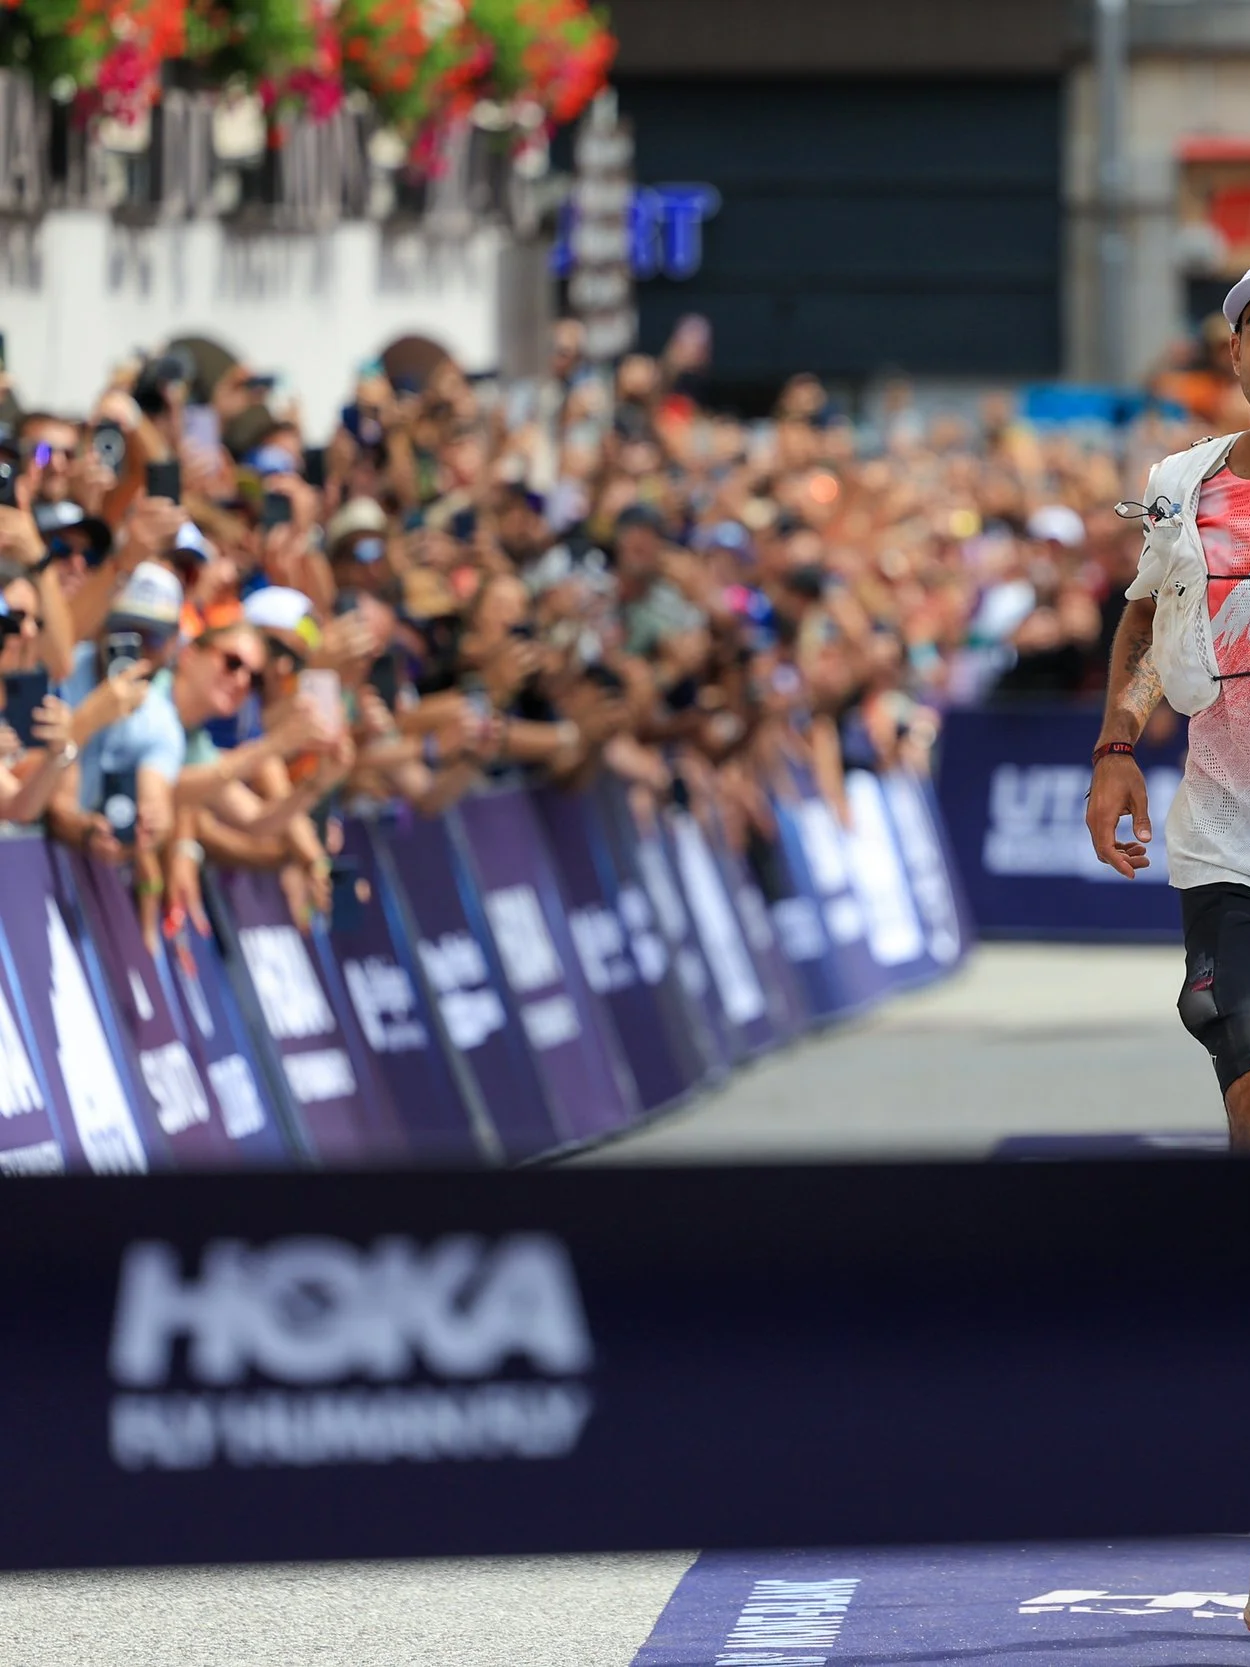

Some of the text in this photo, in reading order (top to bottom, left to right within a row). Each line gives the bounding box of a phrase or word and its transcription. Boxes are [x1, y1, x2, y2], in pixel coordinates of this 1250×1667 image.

[1113, 744, 1132, 752] UTM
[112, 1236, 589, 1385] HOKA
[724, 1578, 862, 1648] MONT-BLANC
